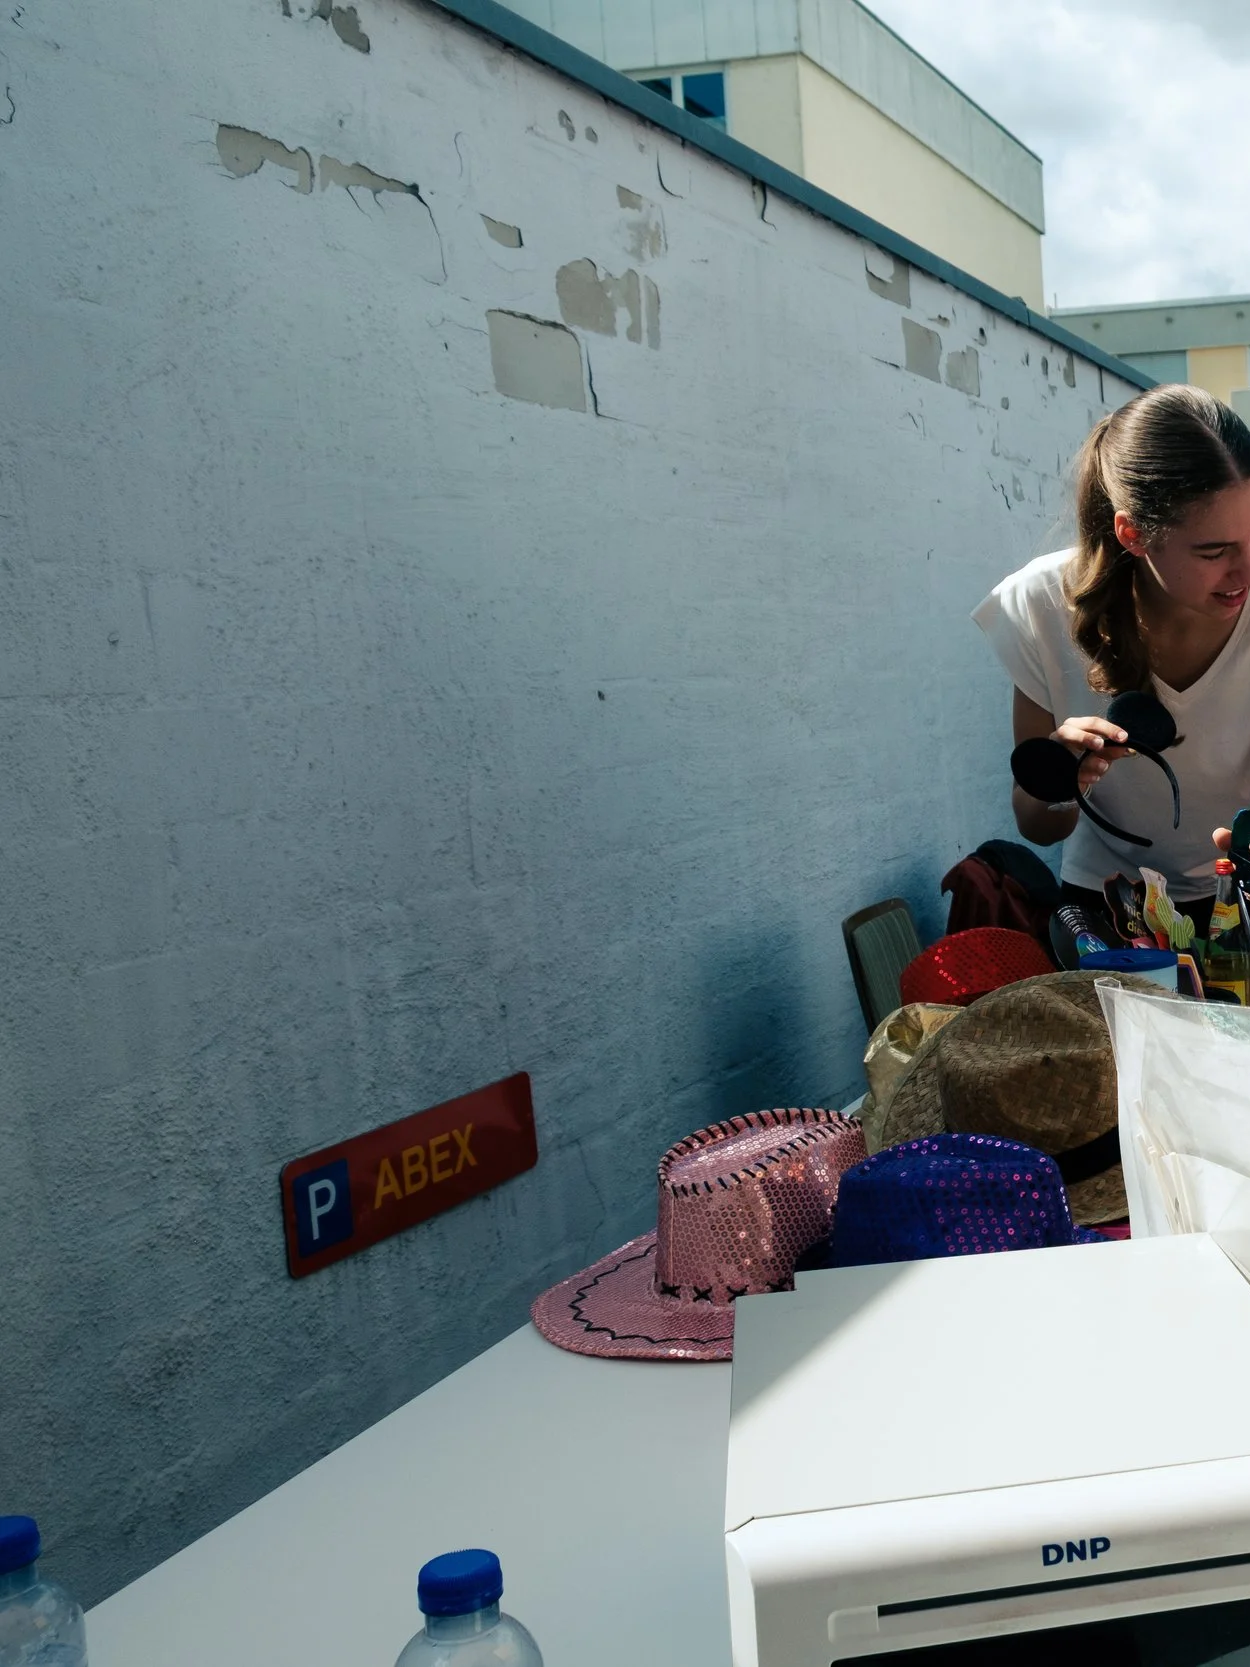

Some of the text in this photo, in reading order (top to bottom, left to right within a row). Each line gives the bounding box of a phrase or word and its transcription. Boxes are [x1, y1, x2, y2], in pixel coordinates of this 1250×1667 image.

[308, 1123, 479, 1241] P ABEX
[1042, 1537, 1111, 1566] DNP
